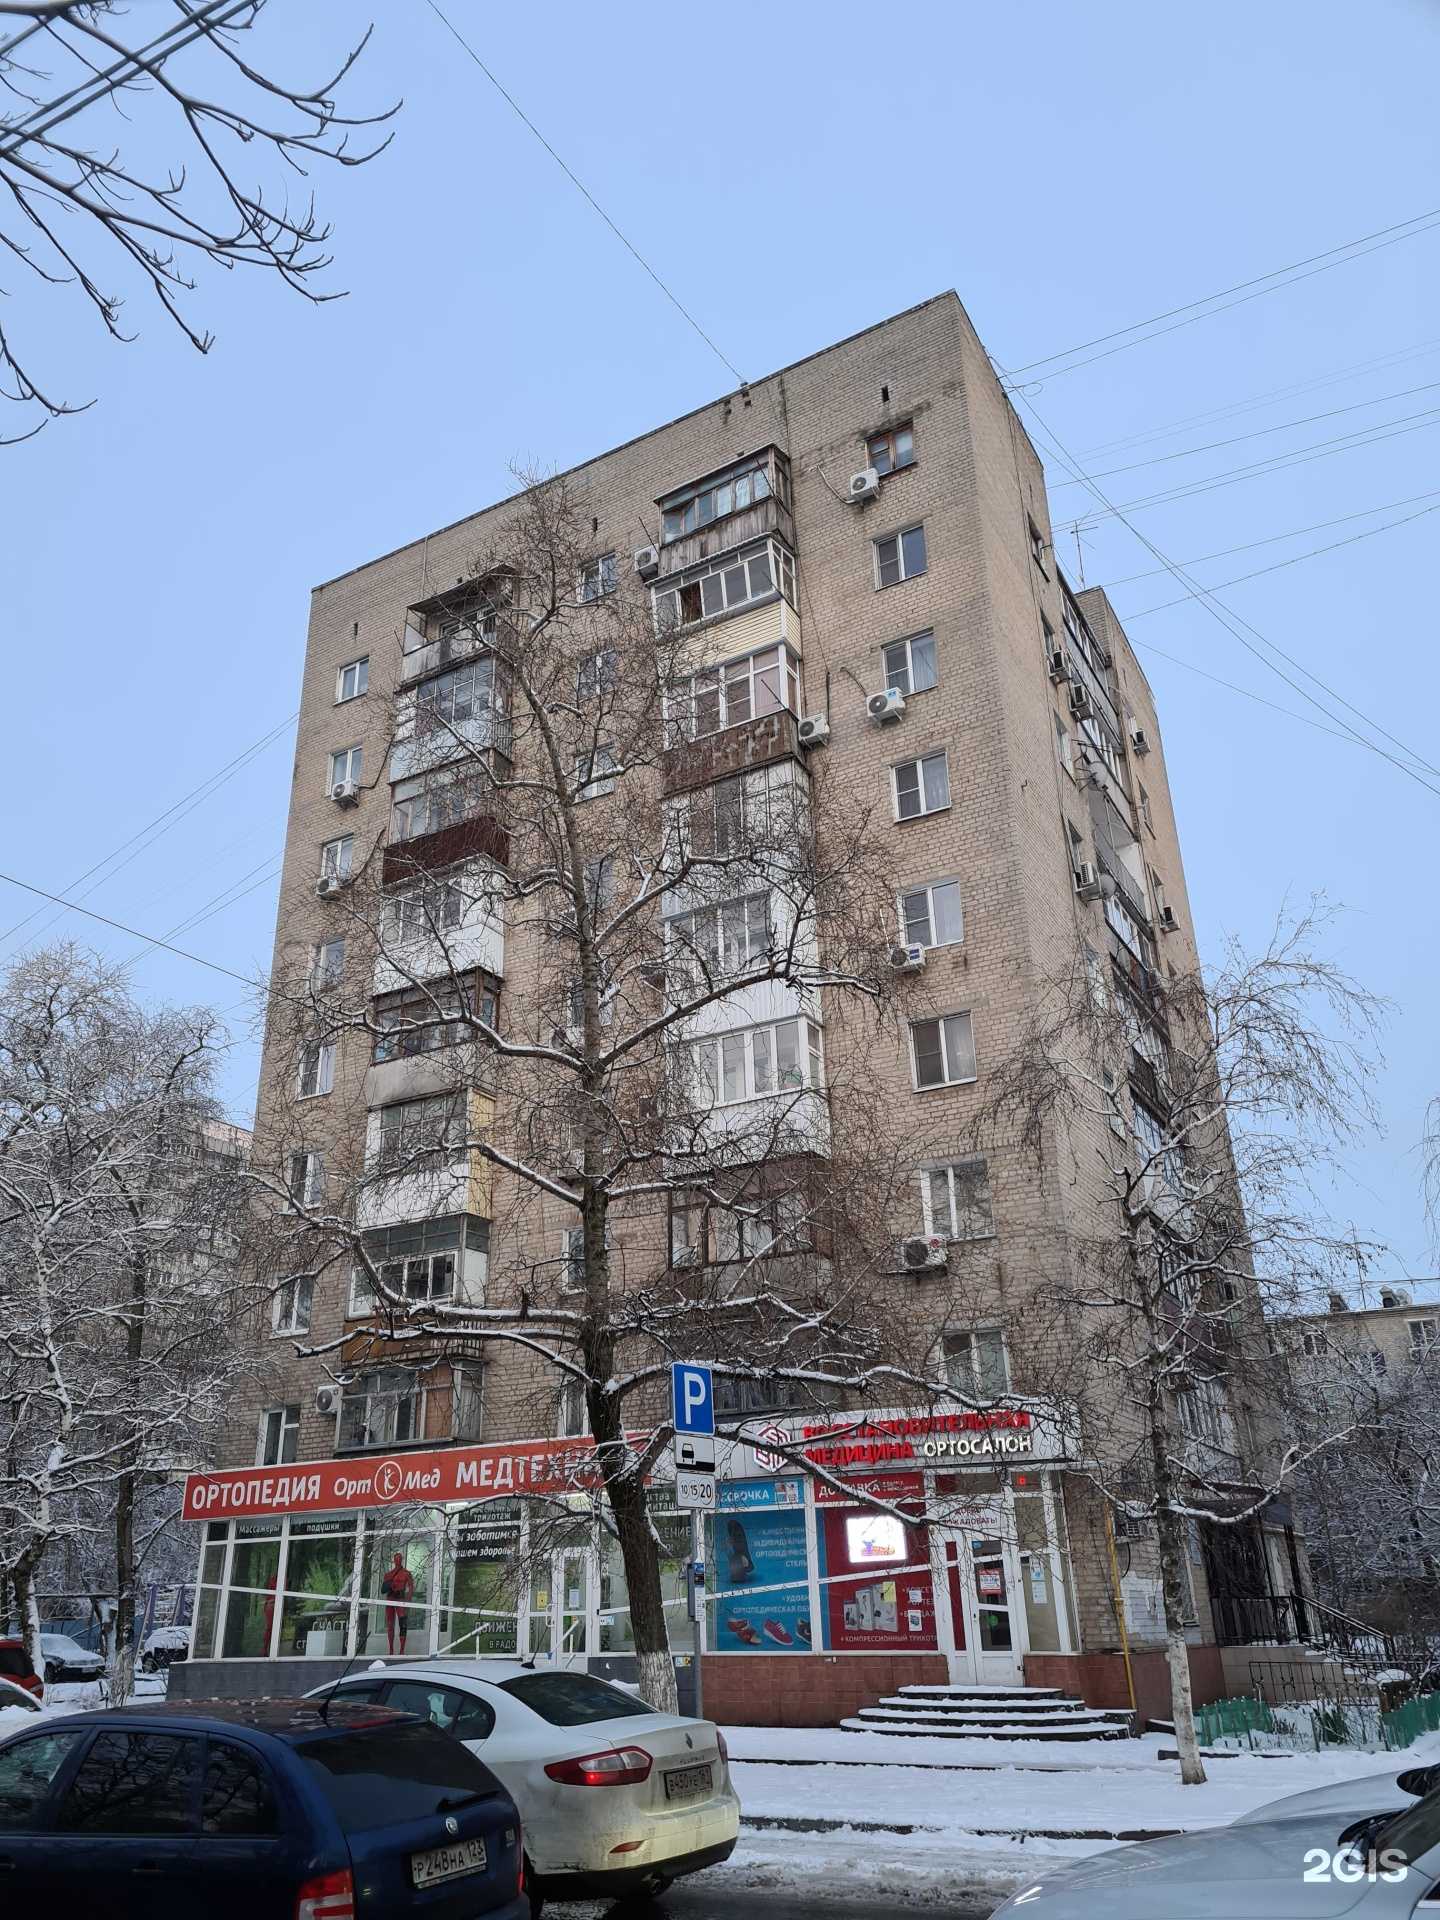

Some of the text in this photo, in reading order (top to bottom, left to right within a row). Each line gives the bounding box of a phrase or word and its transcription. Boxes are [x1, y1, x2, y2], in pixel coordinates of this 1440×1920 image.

[684, 1372, 706, 1425] P
[803, 1434, 1033, 1466] МЕДИЦИНА ОРТОСАЛОН
[192, 1474, 321, 1510] ОРТОПЕДИЯ
[404, 1468, 441, 1490] Мед
[681, 1484, 712, 1498] 10 15 20
[306, 1523, 340, 1533] подушки
